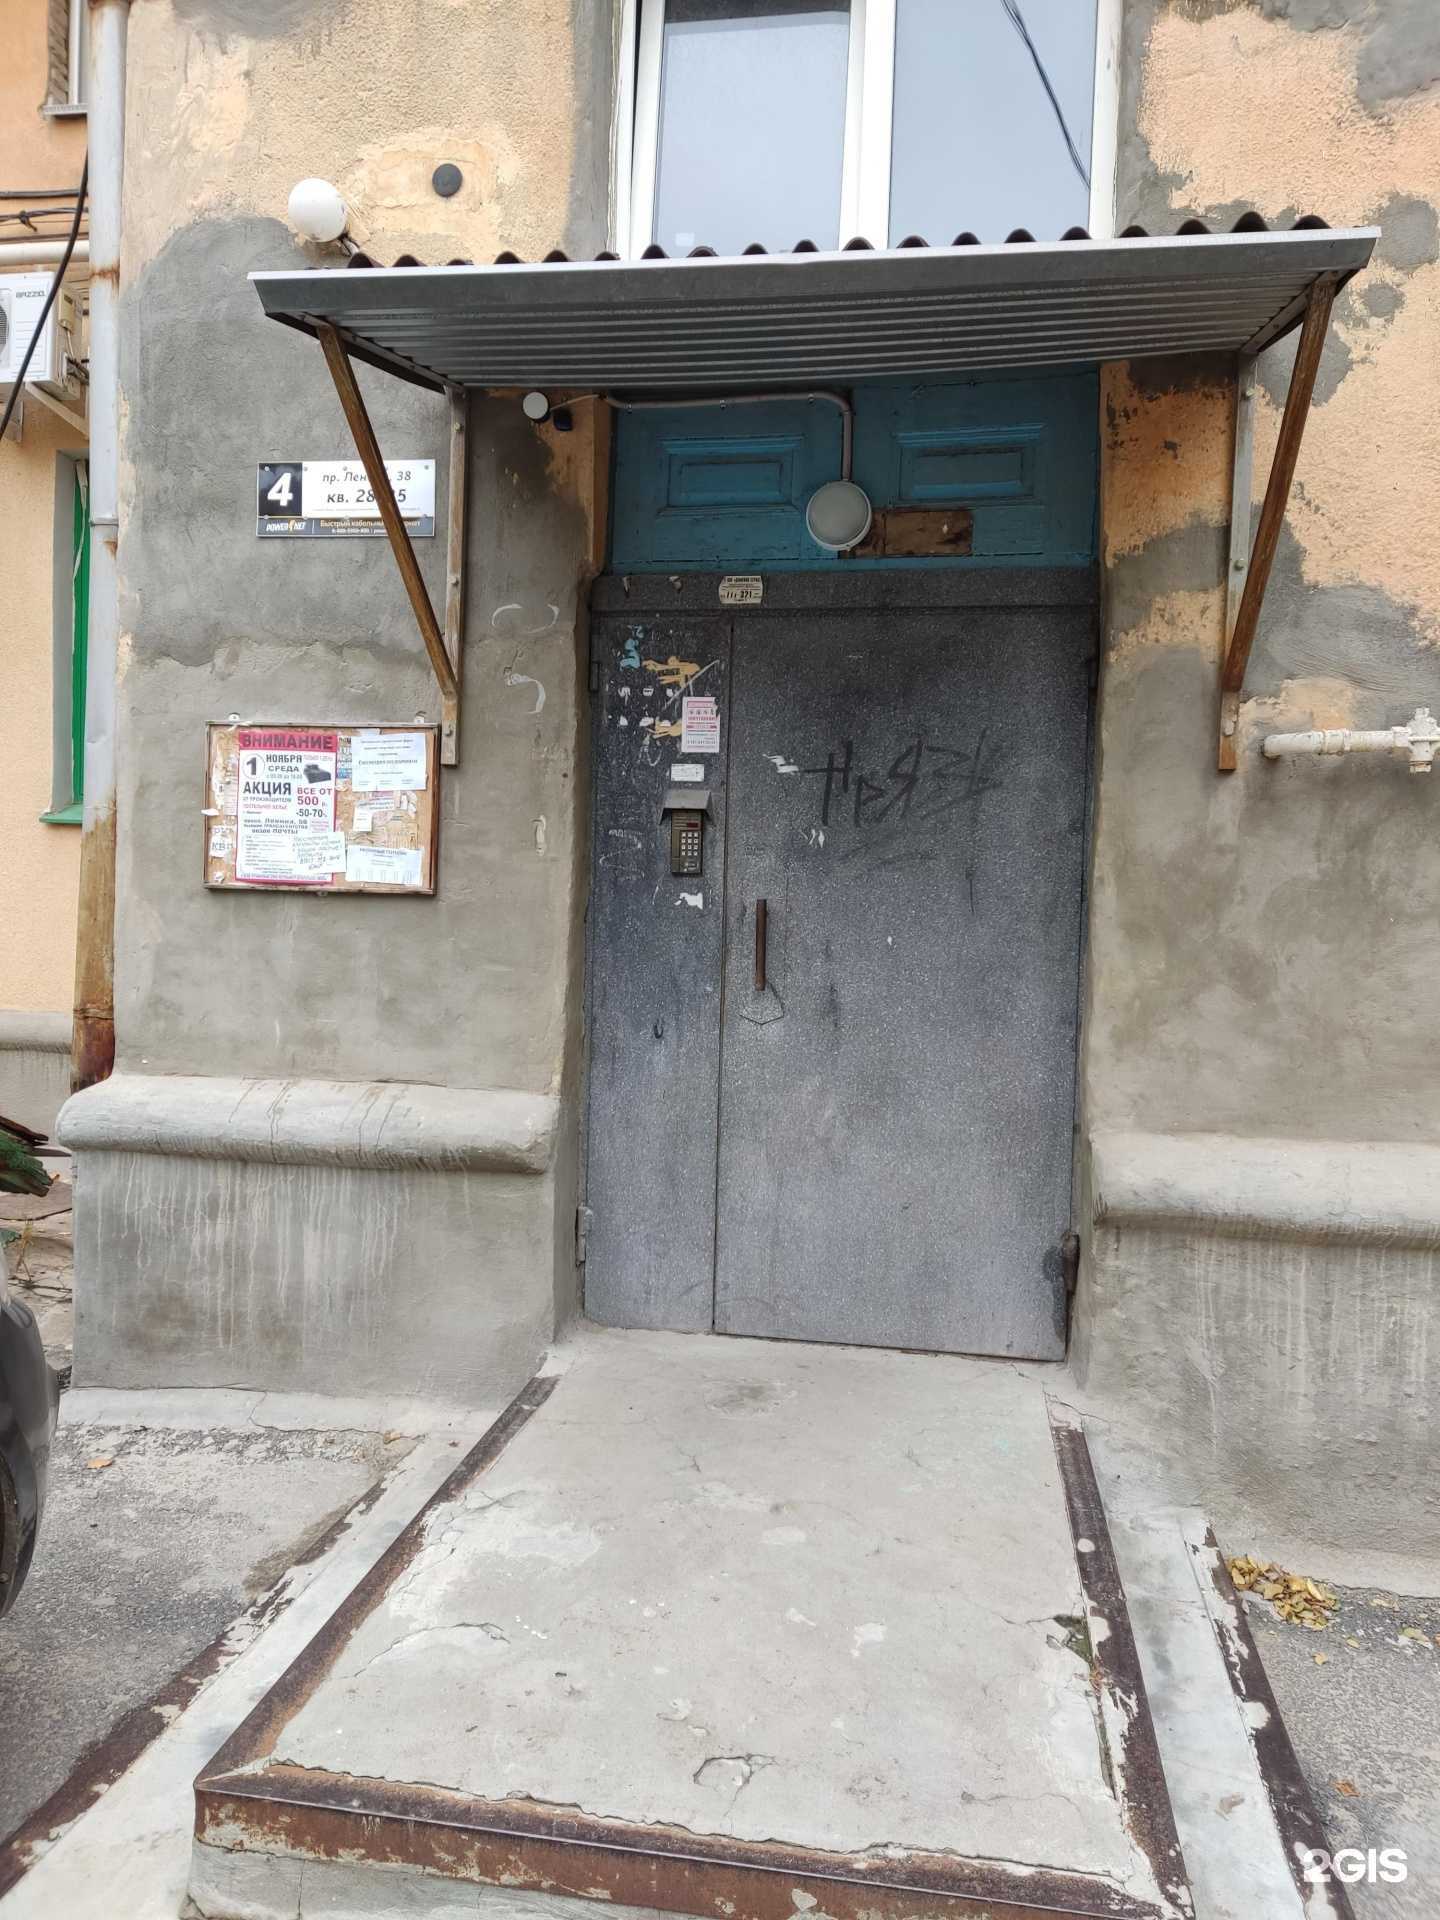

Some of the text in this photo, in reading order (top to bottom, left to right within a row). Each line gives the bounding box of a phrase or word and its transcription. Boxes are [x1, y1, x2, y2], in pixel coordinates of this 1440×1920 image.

[322, 474, 340, 485] пр.
[396, 470, 412, 481] 38
[267, 472, 293, 507] 4
[327, 492, 349, 503] кв.
[243, 734, 333, 749] ВНИМАНИЕ
[266, 754, 302, 763] НОЯБРЯ
[246, 757, 257, 775] 1
[268, 765, 299, 773] СРЕДА
[243, 781, 291, 796] АКЦИЯ
[297, 787, 316, 795] ВСЕ
[297, 796, 319, 806] 500
